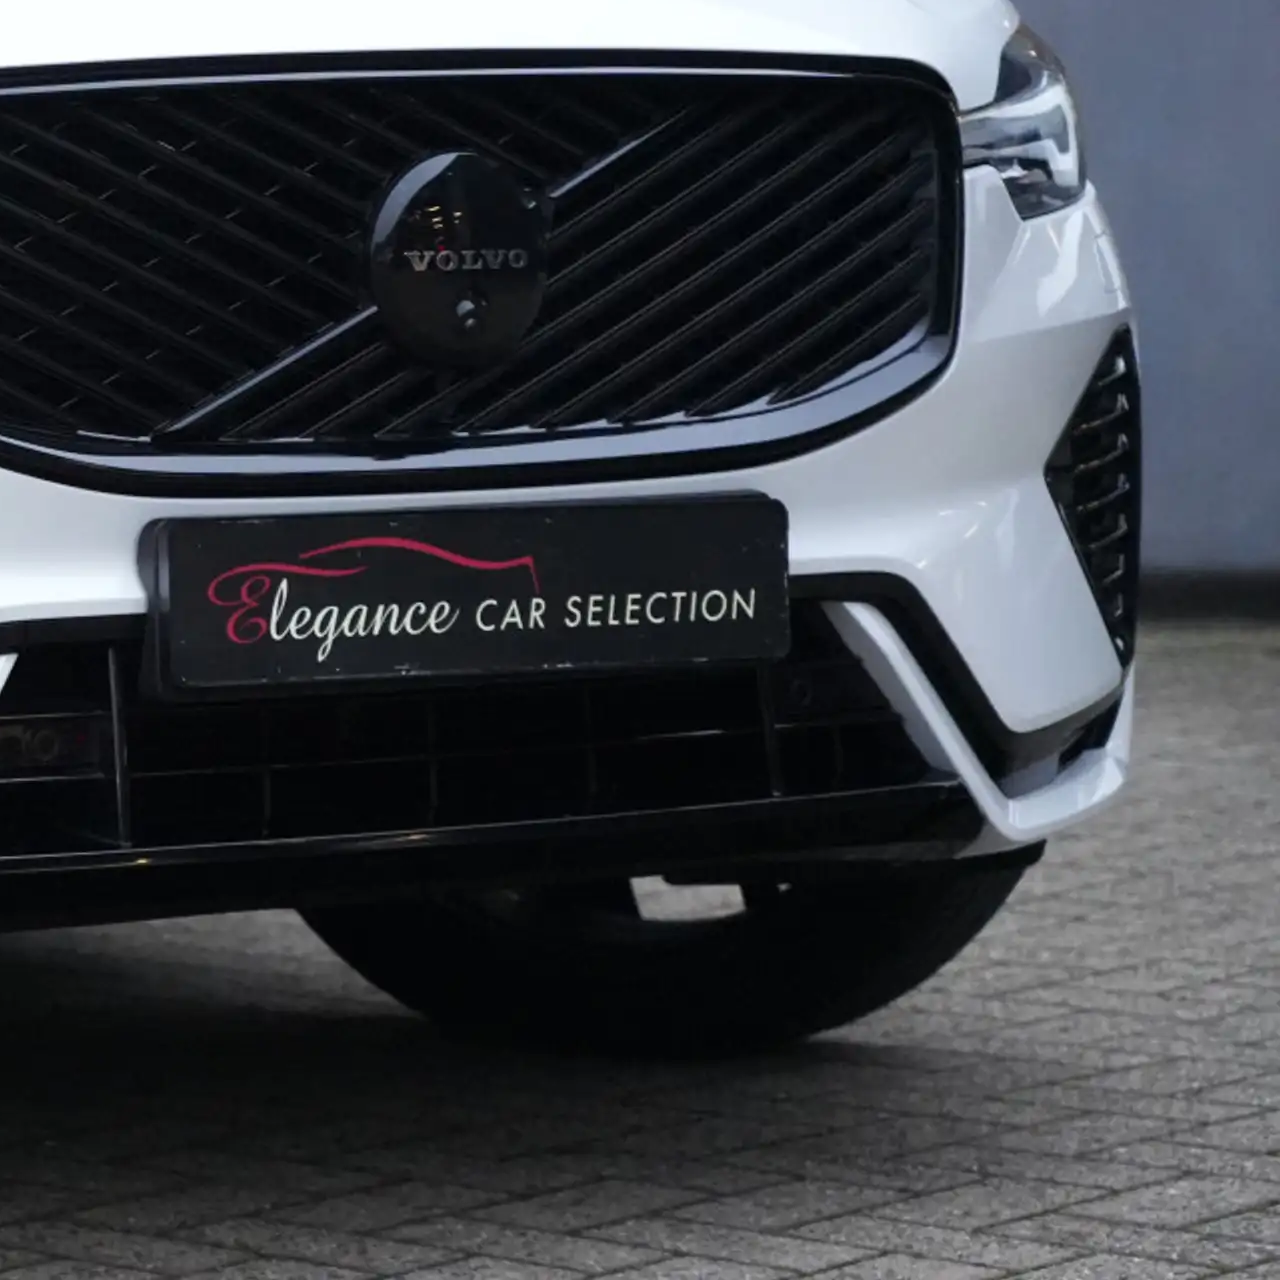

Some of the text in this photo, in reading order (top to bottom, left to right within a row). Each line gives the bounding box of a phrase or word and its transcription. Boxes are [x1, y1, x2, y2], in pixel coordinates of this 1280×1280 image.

[403, 248, 528, 272] VOLVO
[208, 574, 757, 662] Elegance CAR SELECTION
